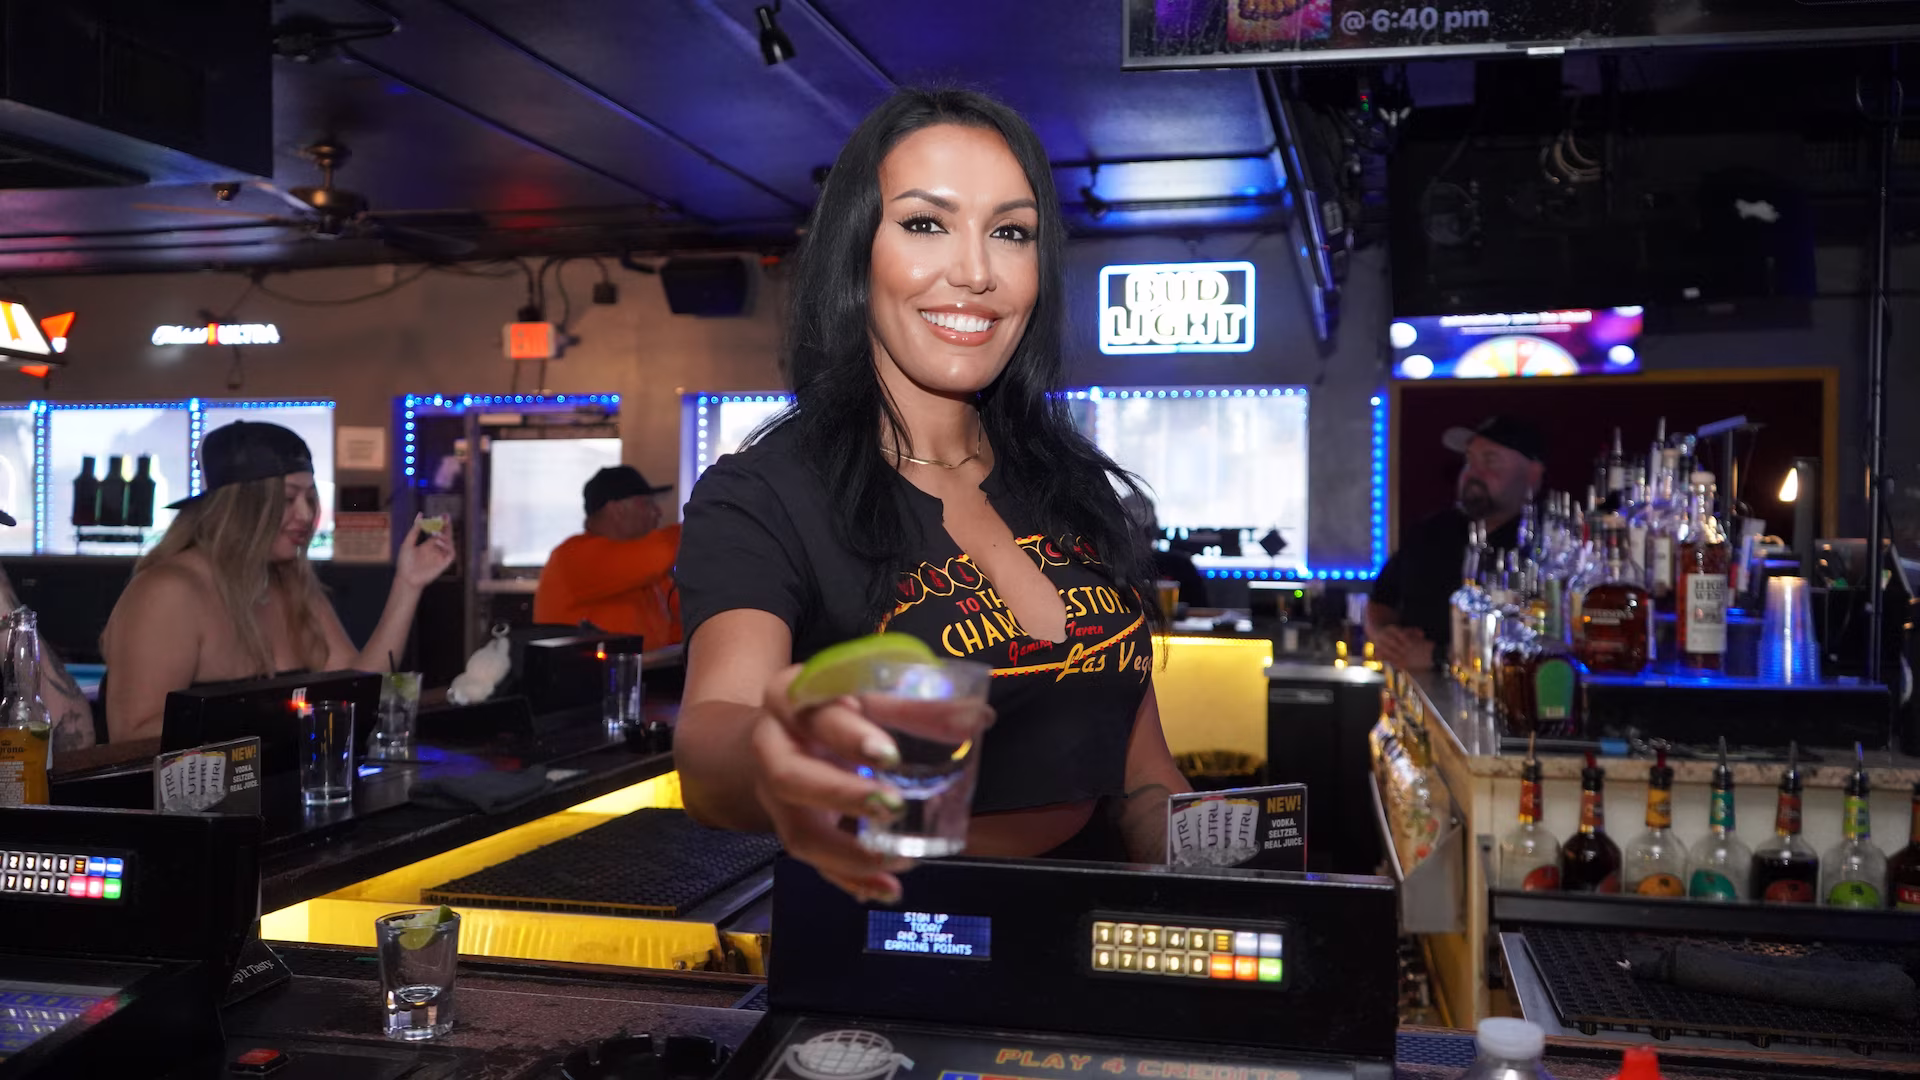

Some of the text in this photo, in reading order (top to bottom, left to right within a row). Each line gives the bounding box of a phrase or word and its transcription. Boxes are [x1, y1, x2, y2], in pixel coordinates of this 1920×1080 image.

[1340, 7, 1489, 35] @ 6:40 pm
[1126, 271, 1229, 312] BUD
[1106, 304, 1247, 345] LIGHT
[956, 588, 1007, 615] TO TH
[1066, 621, 1105, 637] Tavern
[1056, 642, 1107, 683] Las
[231, 745, 257, 762] NEW!
[229, 783, 243, 793] REAL
[1266, 795, 1302, 815] NEW!
[1271, 818, 1297, 828] VODKA.
[1268, 828, 1299, 839] SELTZER.
[1264, 837, 1305, 850] REAL JUICE.
[42, 858, 51, 870] 4
[904, 912, 949, 924] SIGN UP
[910, 922, 942, 933] TODAY
[897, 930, 954, 944] AND START
[1100, 928, 1109, 942] 1
[1123, 930, 1133, 943] 2
[1147, 931, 1156, 945] 3
[1170, 933, 1180, 946] 4
[1194, 934, 1203, 948] 5
[884, 939, 972, 955] EARNING POINTS
[246, 960, 275, 975] Tasty.
[1100, 952, 1109, 966] 6
[1122, 953, 1133, 967] 7
[1146, 955, 1156, 969] 8
[996, 1048, 1092, 1071] PLAY
[1102, 1057, 1126, 1075] 4
